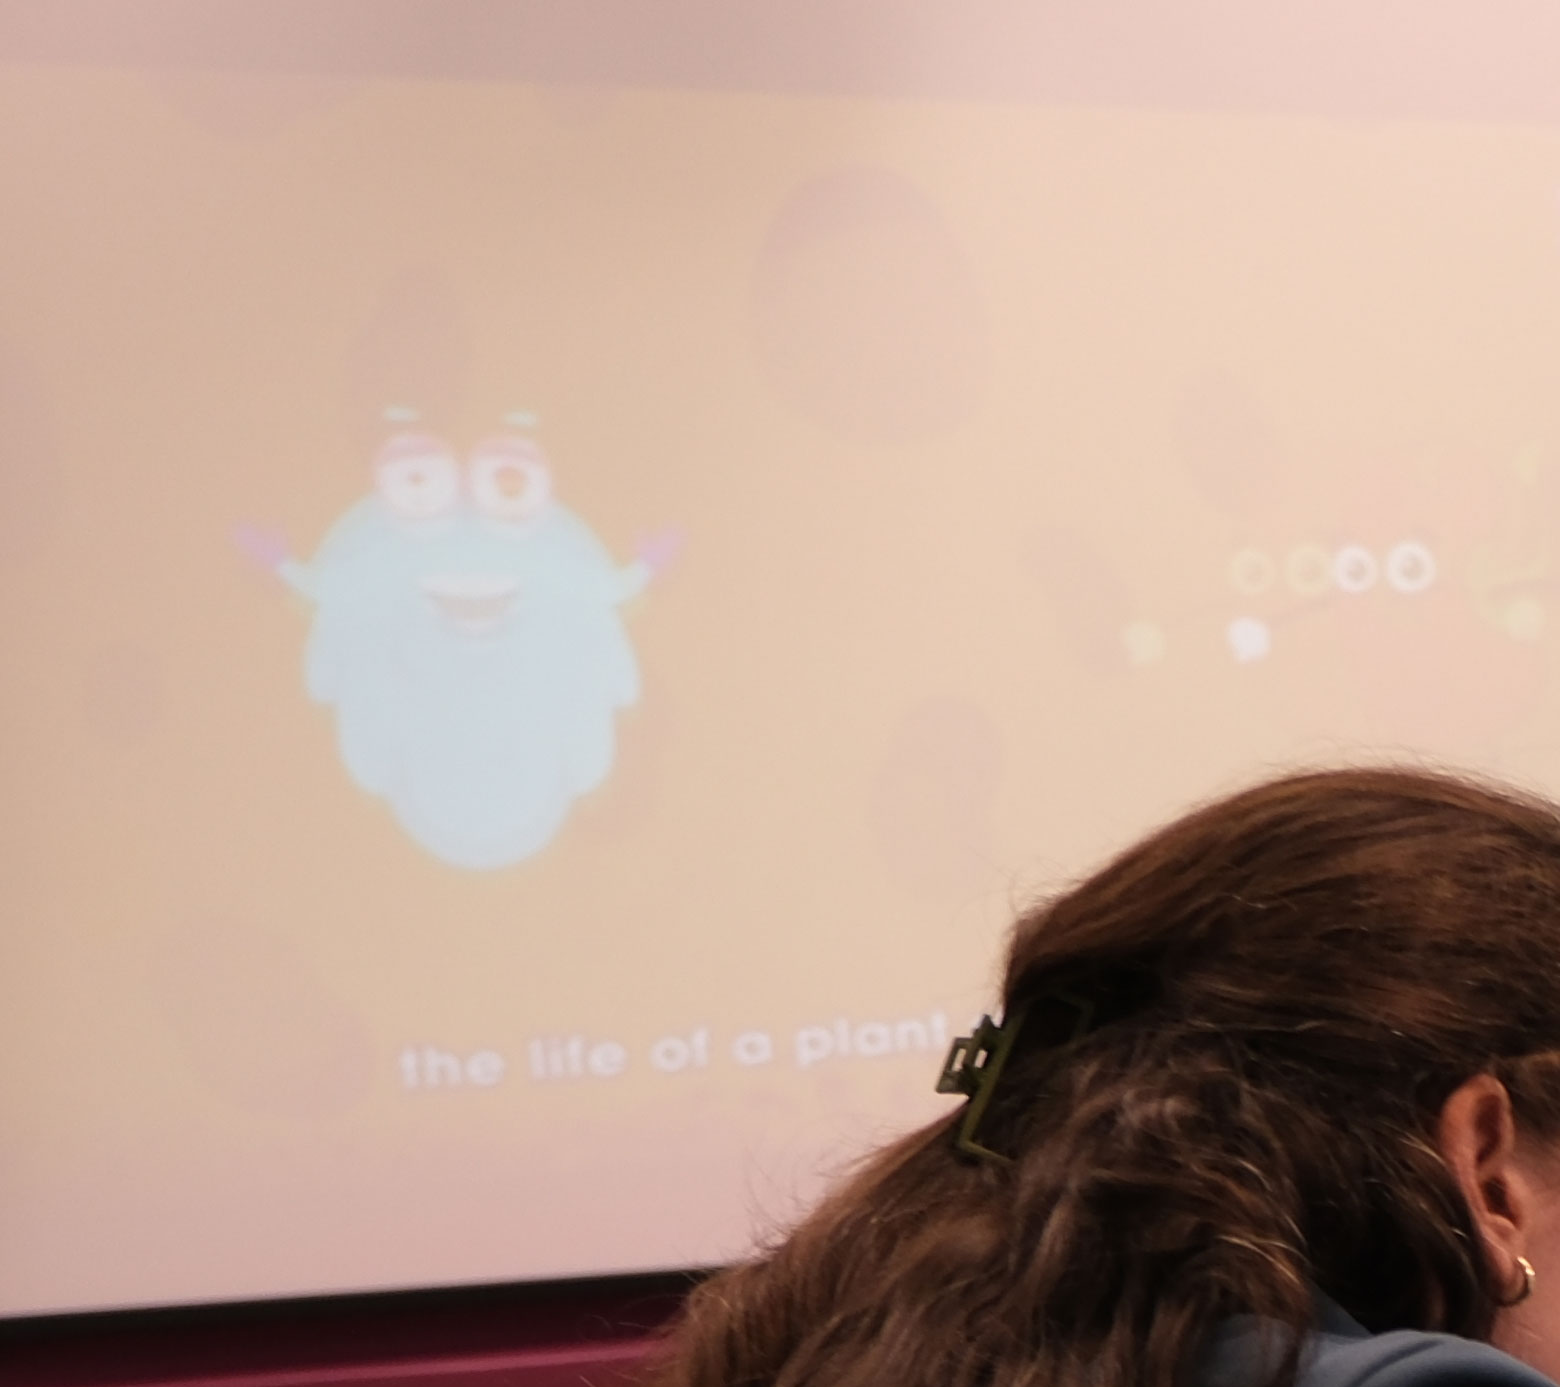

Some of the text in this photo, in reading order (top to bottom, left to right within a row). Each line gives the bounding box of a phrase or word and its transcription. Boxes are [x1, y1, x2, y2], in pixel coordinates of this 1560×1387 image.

[399, 1011, 949, 1088] the life of a plant
